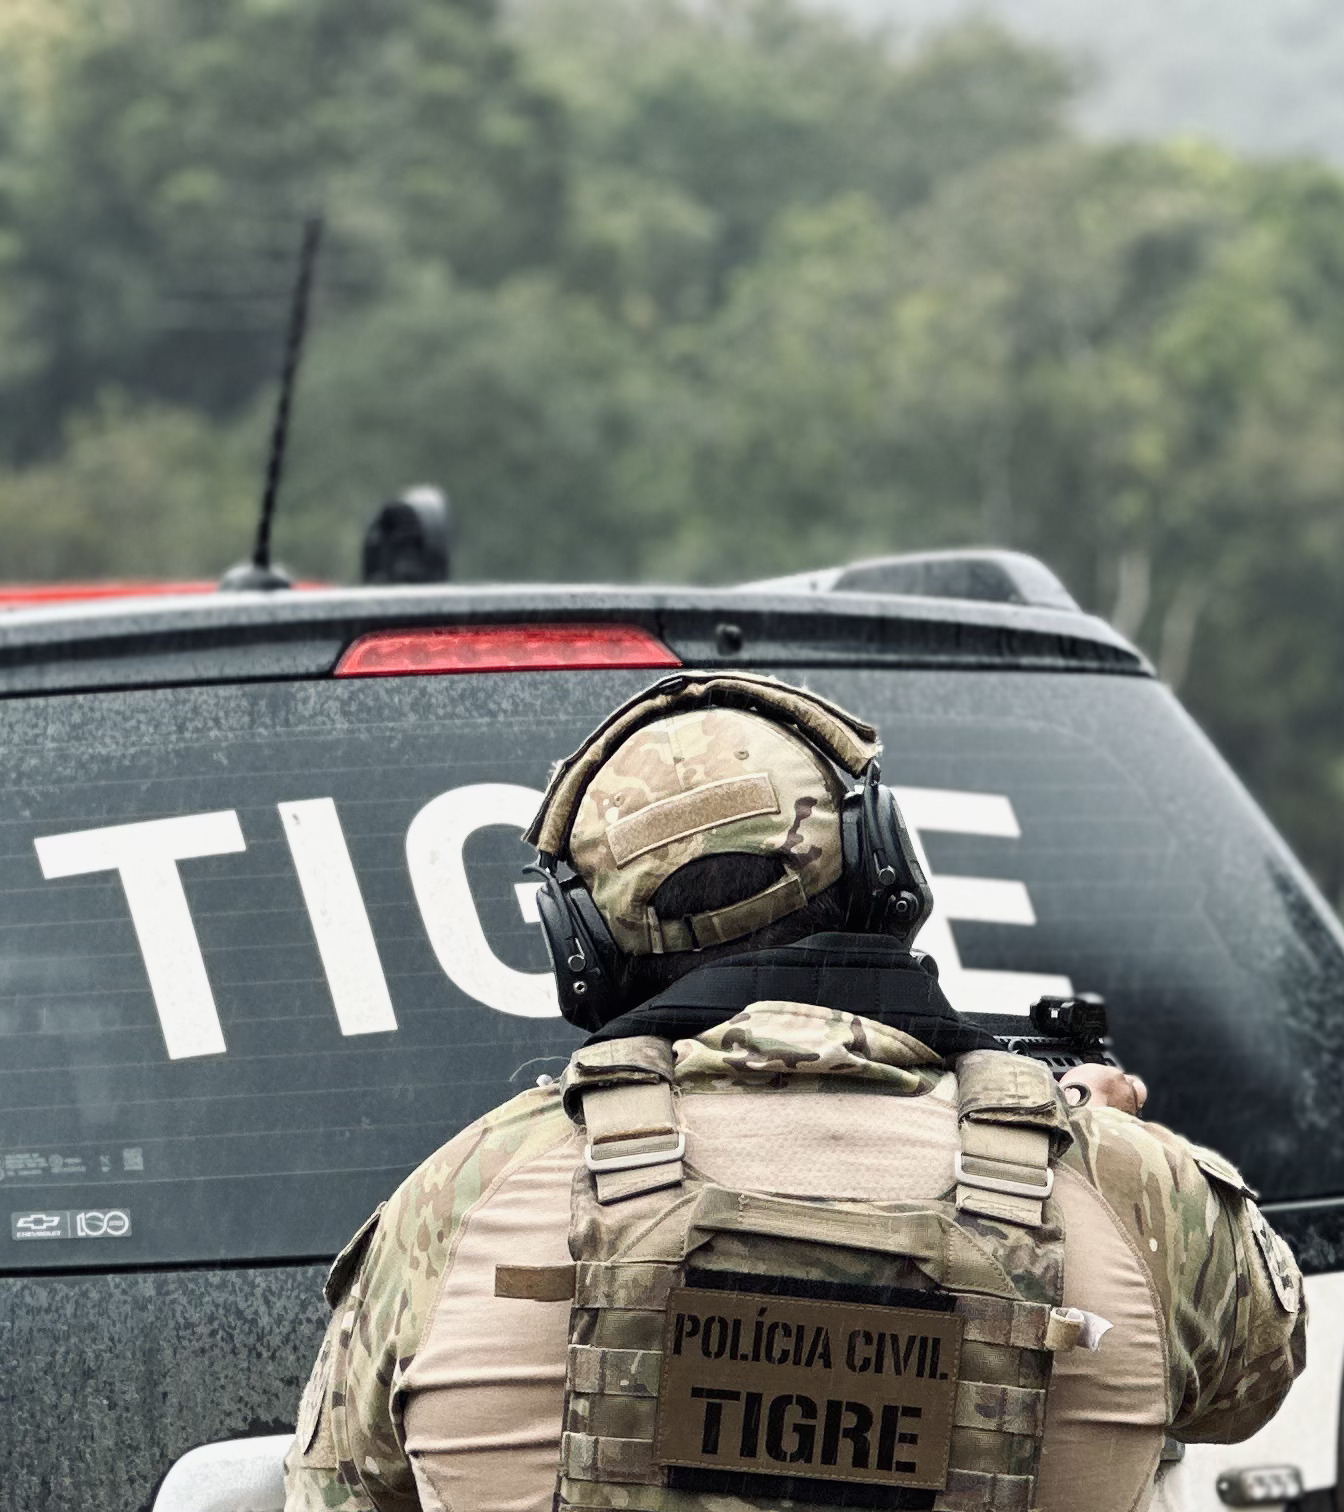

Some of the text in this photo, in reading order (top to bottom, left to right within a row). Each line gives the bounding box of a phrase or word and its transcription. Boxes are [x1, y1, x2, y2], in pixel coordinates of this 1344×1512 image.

[34, 782, 1072, 1062] TIGE
[672, 1306, 949, 1381] POLÍCIA CIVIL
[689, 1386, 923, 1474] TIGRE
